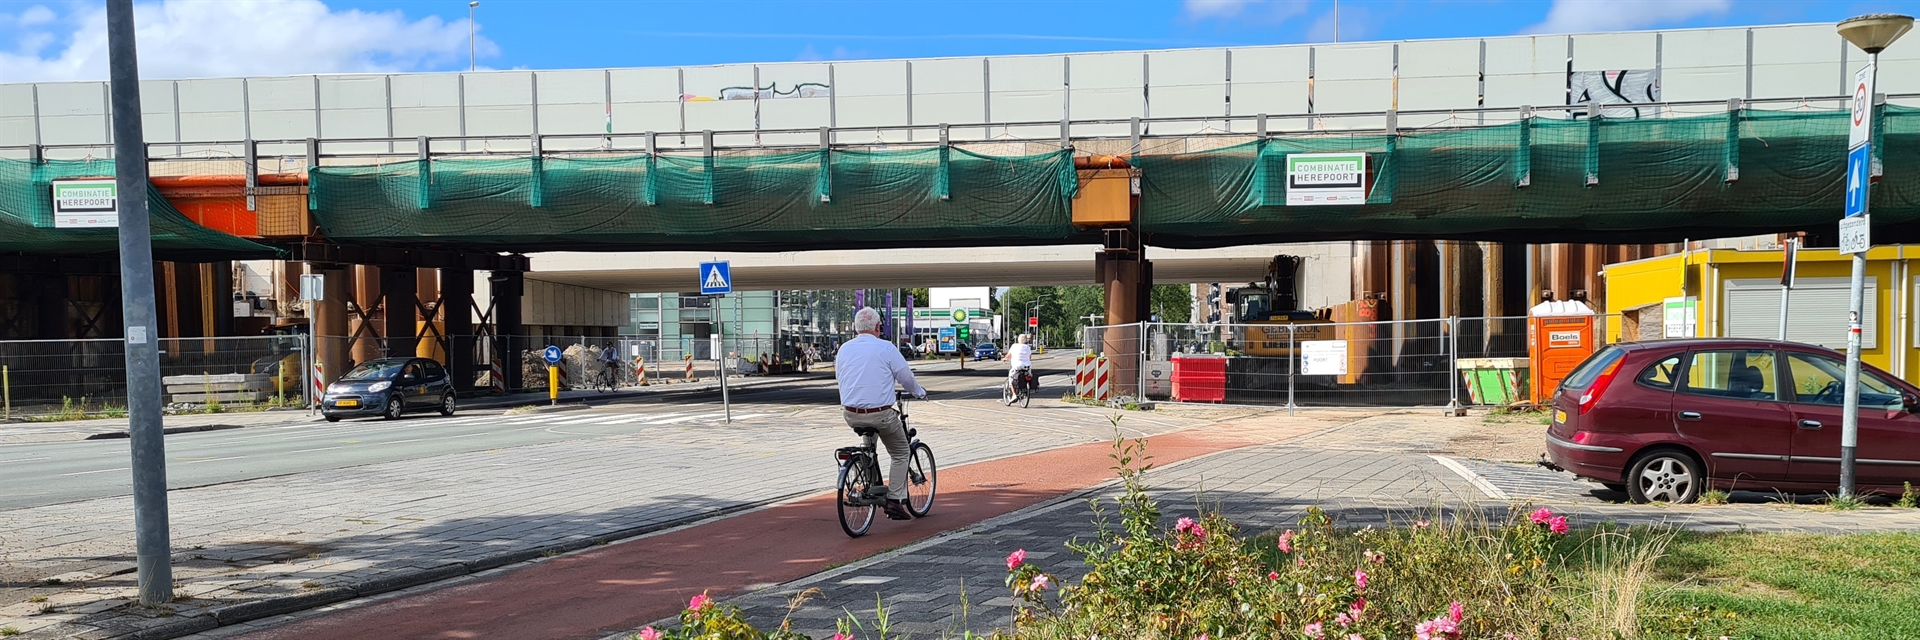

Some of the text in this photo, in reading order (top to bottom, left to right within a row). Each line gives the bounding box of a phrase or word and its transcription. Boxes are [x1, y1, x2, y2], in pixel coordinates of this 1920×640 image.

[1856, 95, 1864, 114] 30
[1297, 163, 1355, 172] COMBINATIE
[1297, 173, 1355, 181] HEREPOORT
